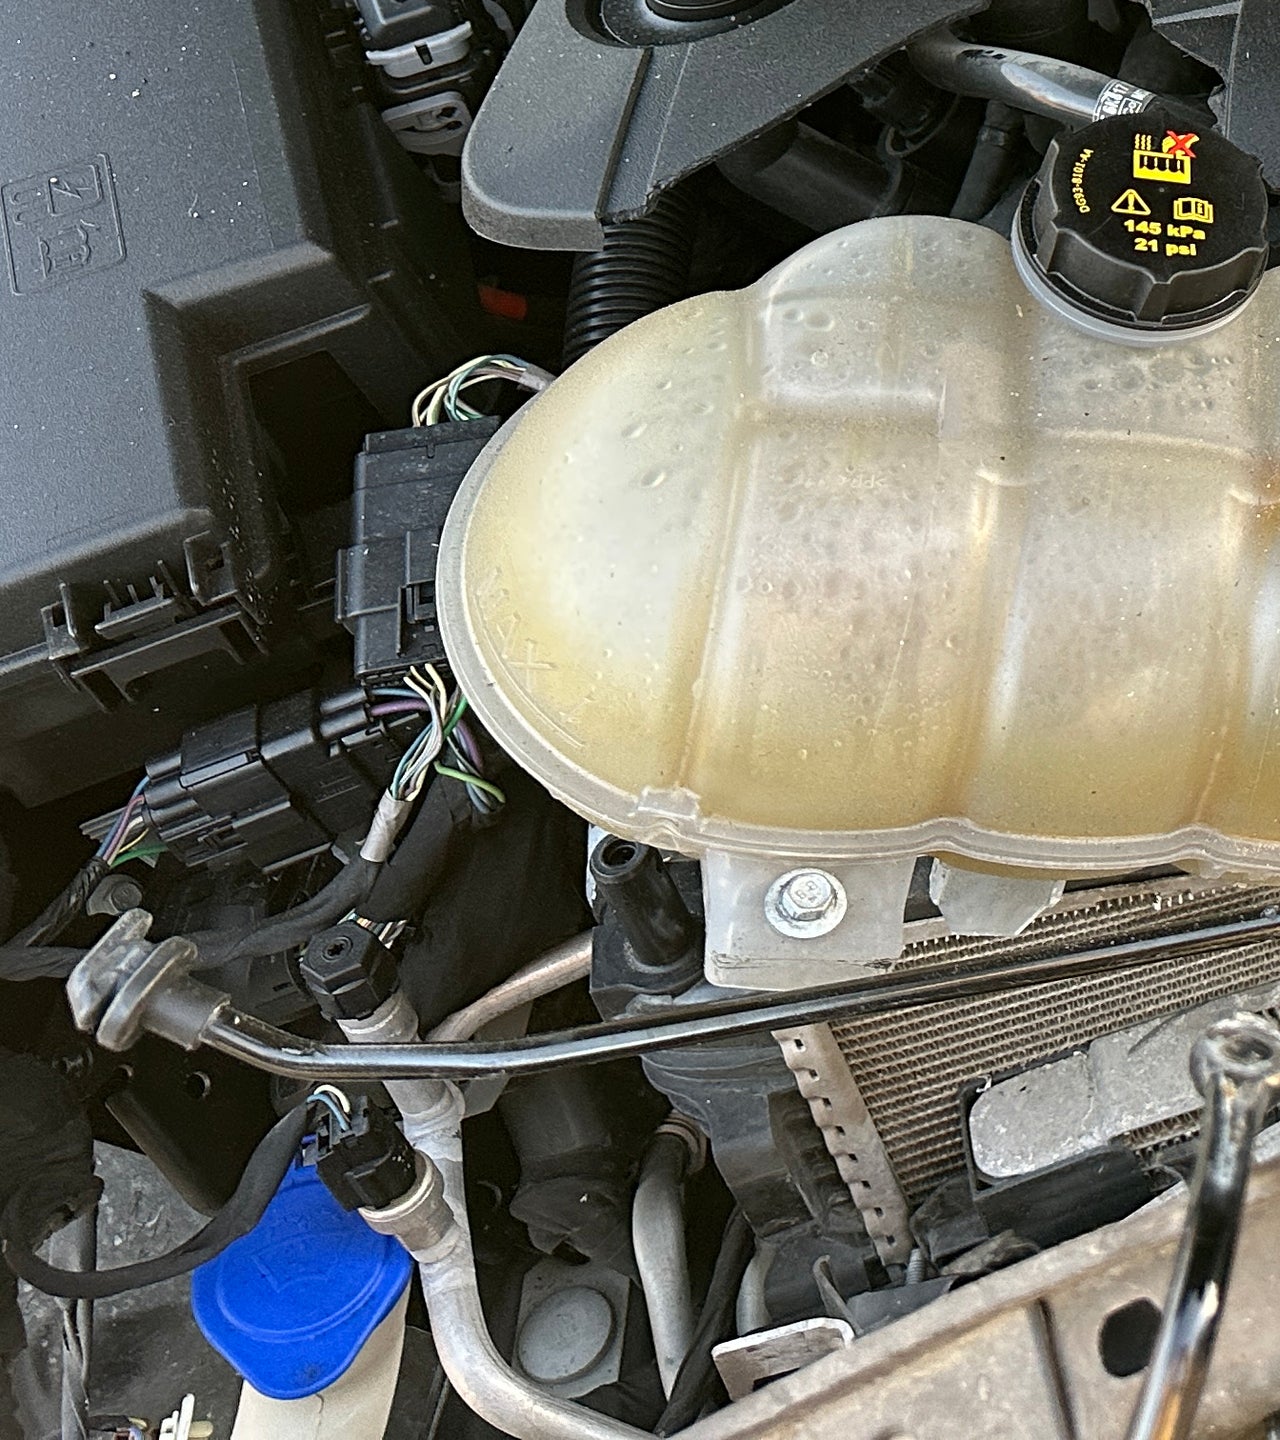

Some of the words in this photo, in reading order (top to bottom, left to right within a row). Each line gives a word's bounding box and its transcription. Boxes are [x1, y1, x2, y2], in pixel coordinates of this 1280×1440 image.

[1124, 219, 1162, 236] 145
[1166, 223, 1206, 240] kPa
[1133, 237, 1159, 252] 21
[1165, 243, 1197, 257] psi
